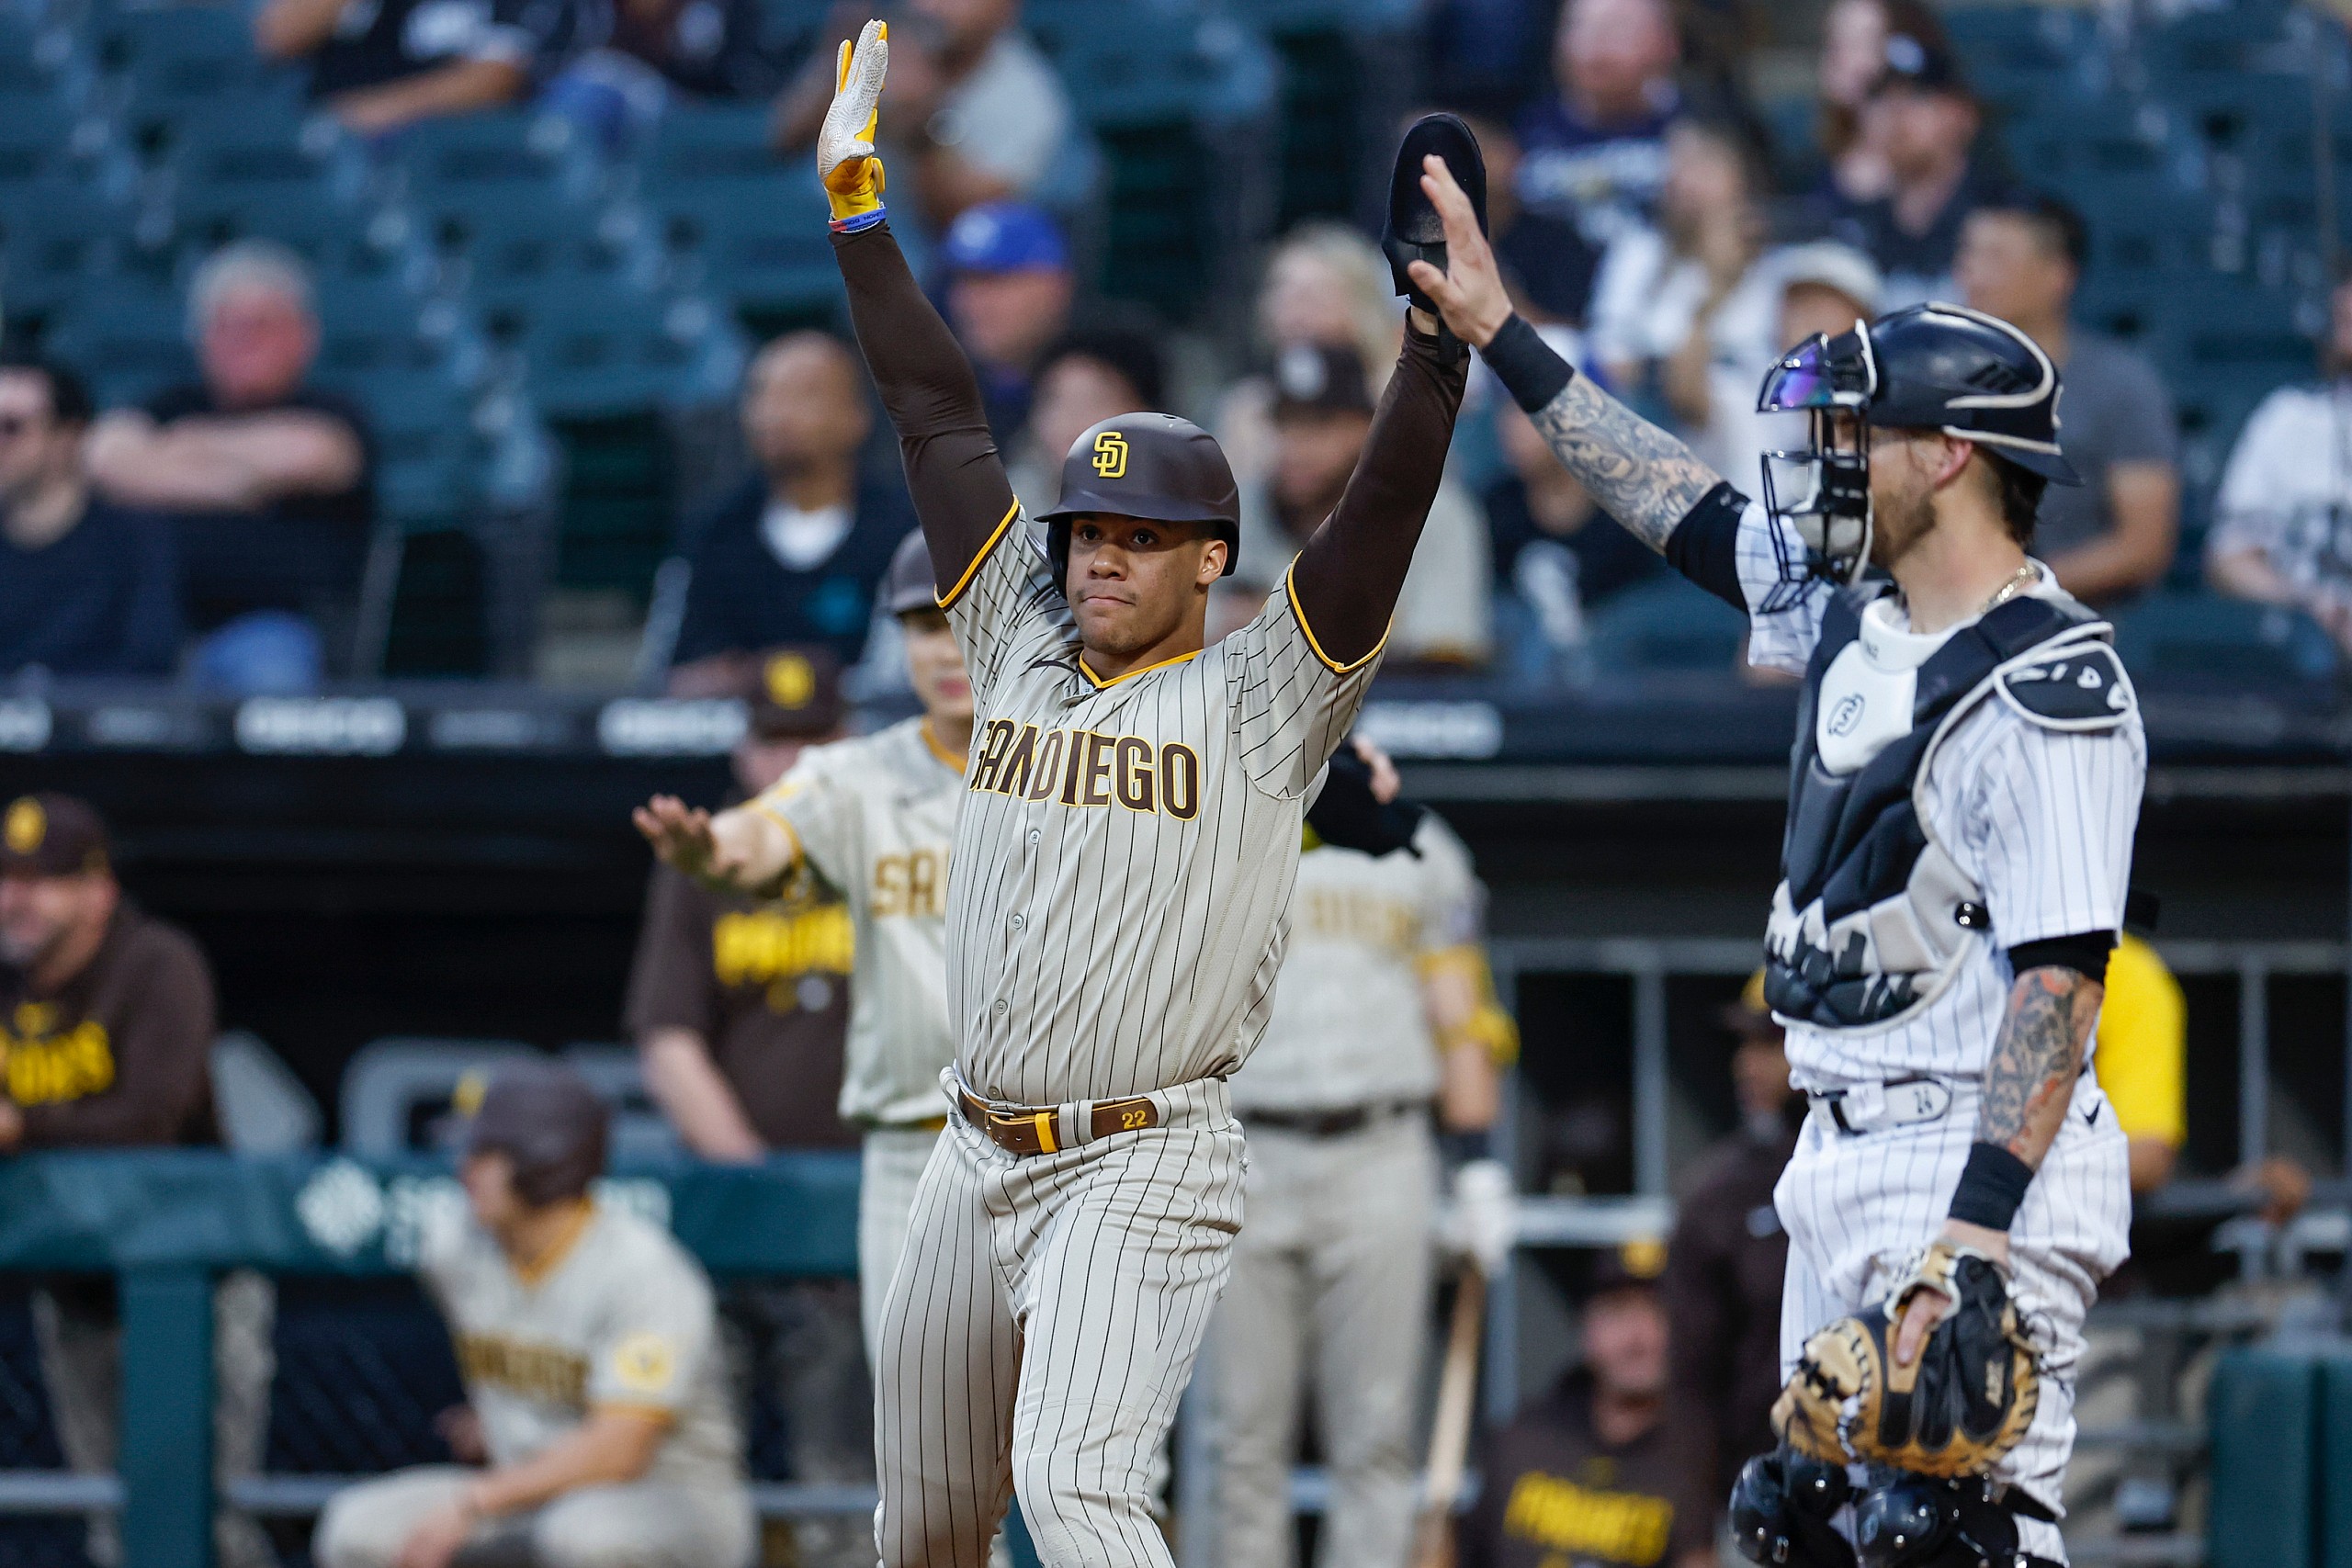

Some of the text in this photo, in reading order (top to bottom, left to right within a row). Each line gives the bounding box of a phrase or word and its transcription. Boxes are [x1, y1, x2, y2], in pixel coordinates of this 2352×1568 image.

[1092, 431, 1129, 479] SD
[870, 847, 947, 918] SA
[1122, 1110, 1148, 1130] 22
